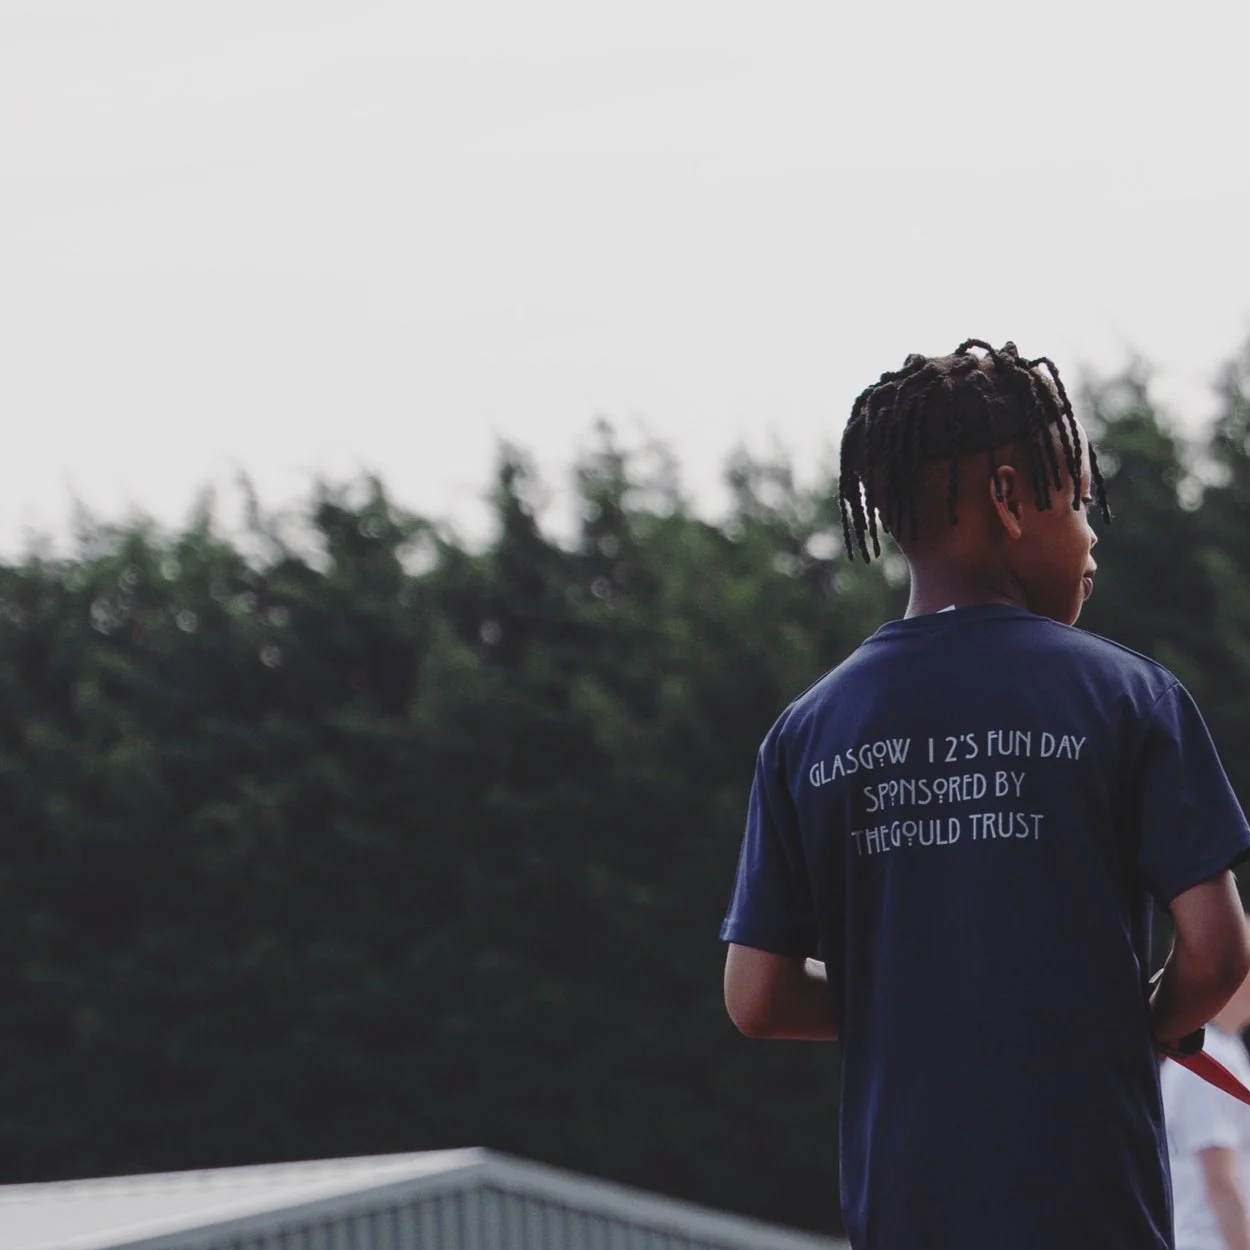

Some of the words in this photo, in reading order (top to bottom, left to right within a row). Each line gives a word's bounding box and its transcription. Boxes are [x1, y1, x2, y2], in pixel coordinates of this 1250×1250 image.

[808, 738, 911, 787] GLASGOW
[987, 730, 1032, 757] FUN
[1040, 732, 1087, 760] DAY
[863, 773, 988, 812] SPONSORED
[995, 771, 1025, 797] BY
[968, 812, 1044, 840] TRUST
